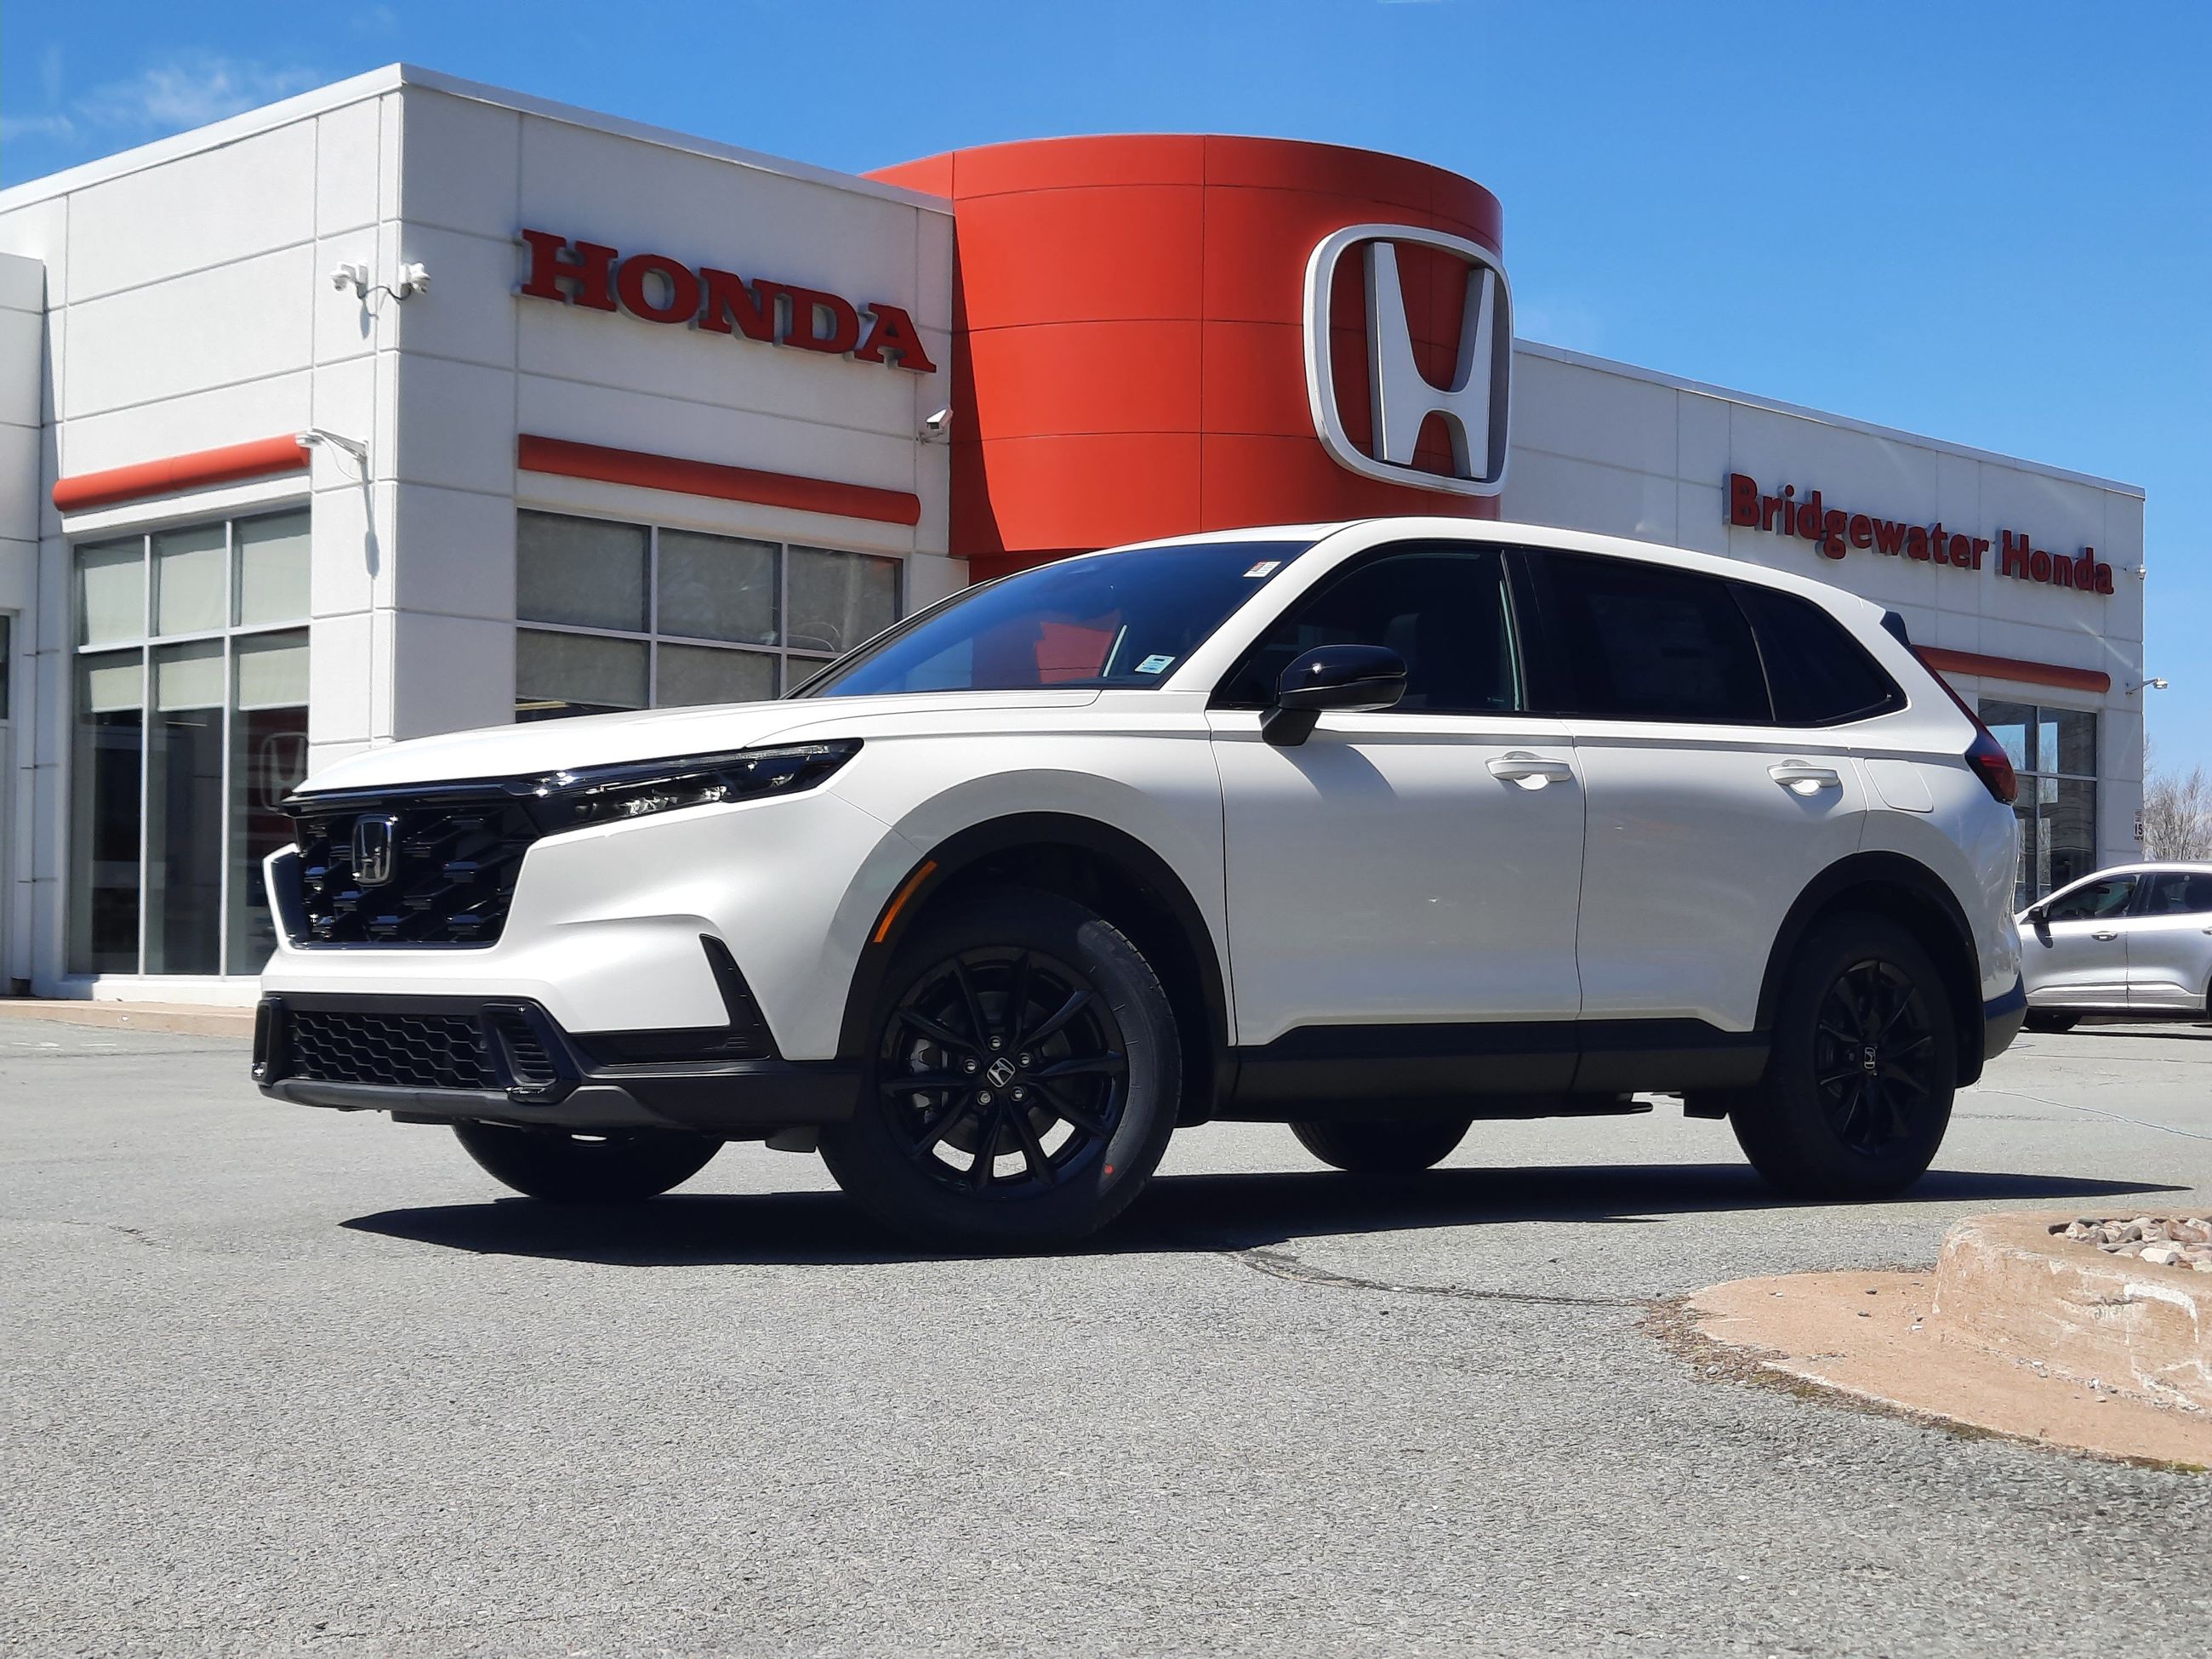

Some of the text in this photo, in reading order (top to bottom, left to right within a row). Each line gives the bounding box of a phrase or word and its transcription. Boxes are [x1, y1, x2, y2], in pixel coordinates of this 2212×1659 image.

[521, 228, 937, 373] HONDA
[1729, 473, 2115, 595] Bridgewater Honda
